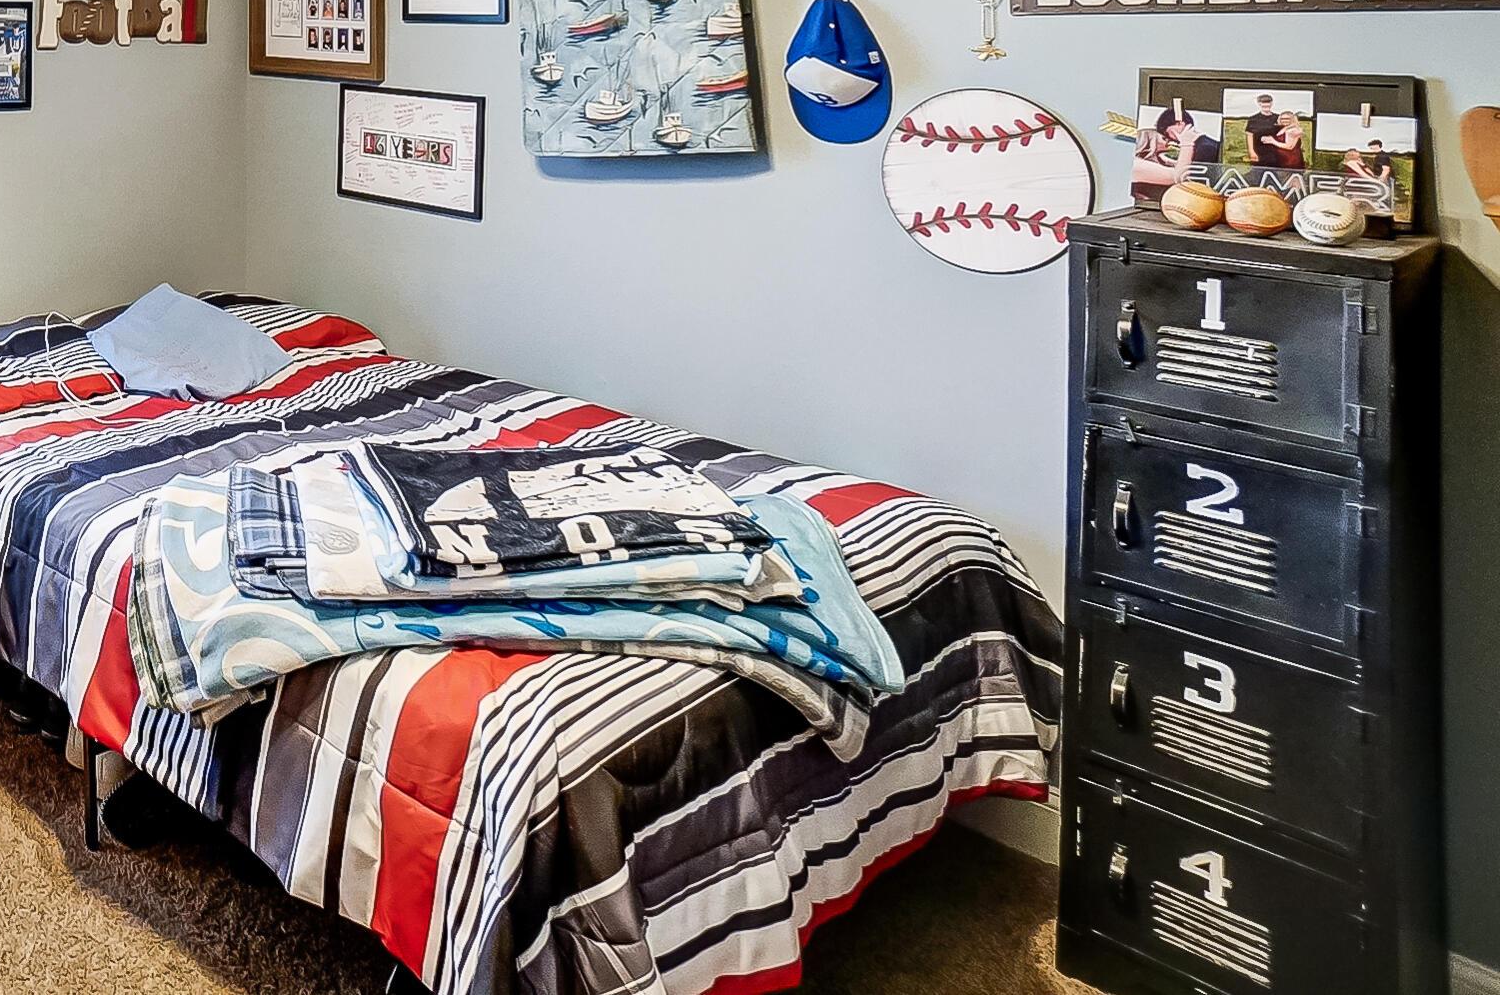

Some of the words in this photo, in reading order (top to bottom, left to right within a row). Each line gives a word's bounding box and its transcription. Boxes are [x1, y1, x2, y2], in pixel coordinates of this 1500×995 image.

[1196, 277, 1226, 331] 1
[1185, 463, 1244, 525] 2
[1184, 651, 1237, 714] 3
[1179, 849, 1233, 906] 4
